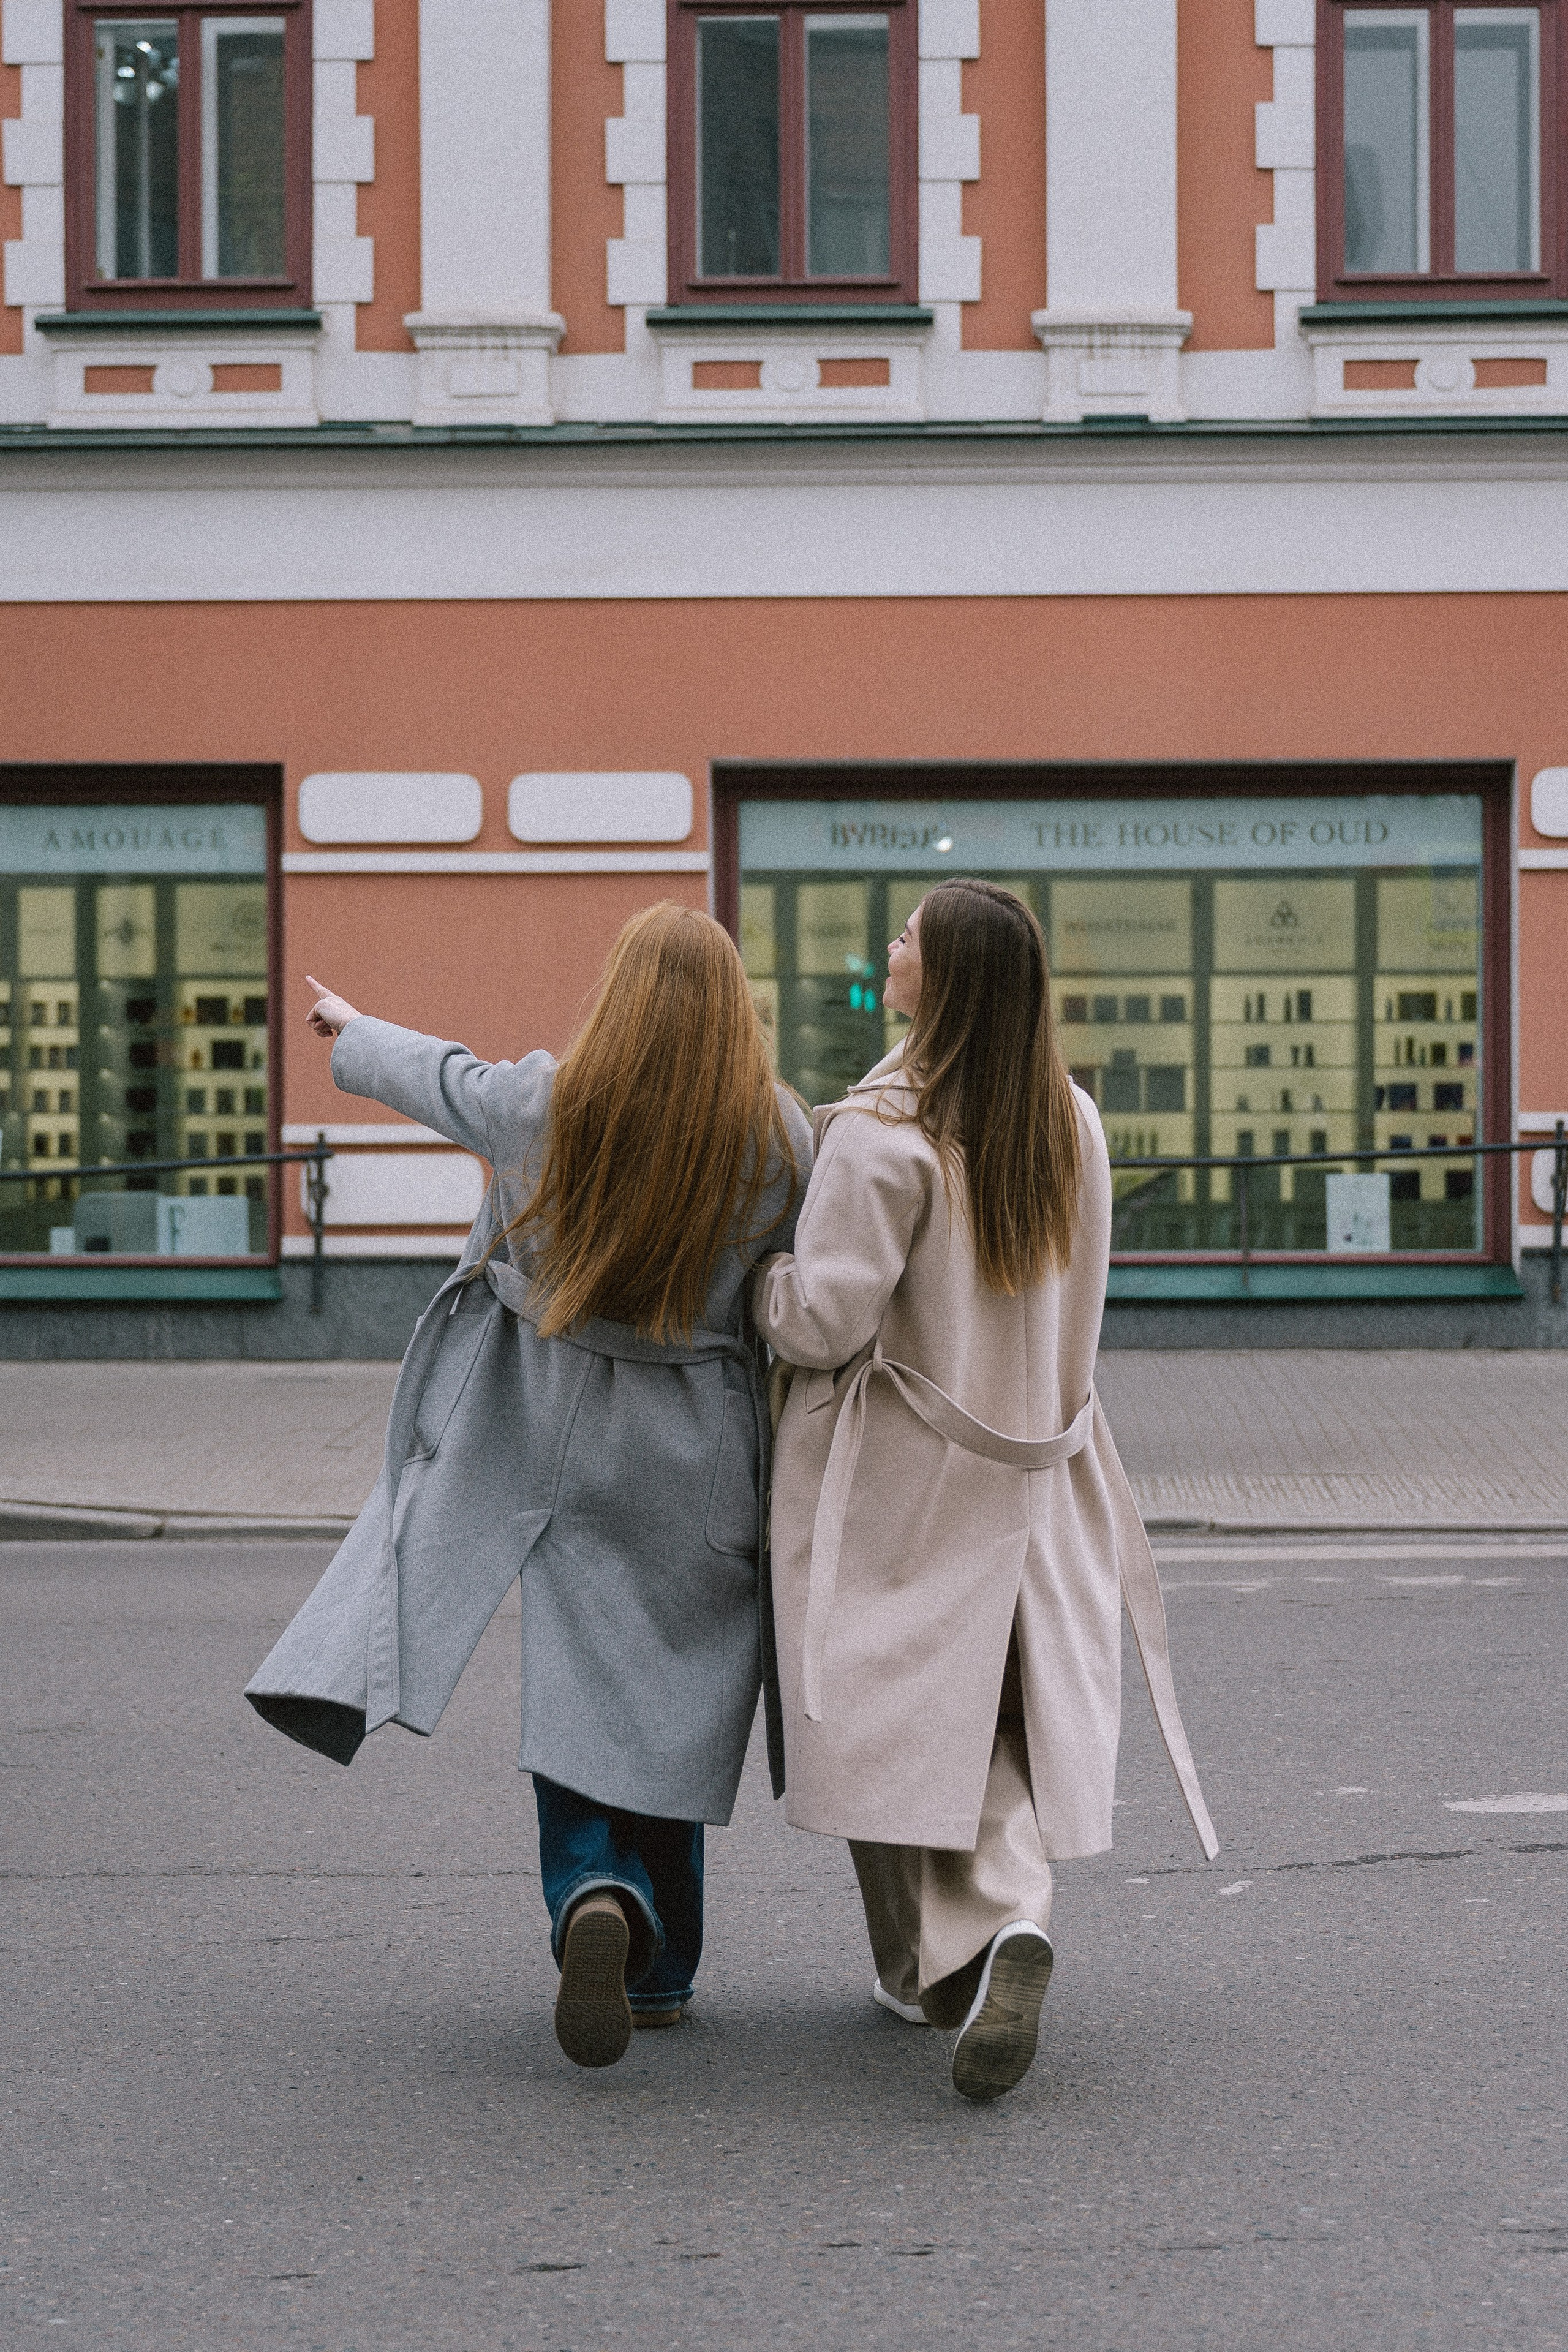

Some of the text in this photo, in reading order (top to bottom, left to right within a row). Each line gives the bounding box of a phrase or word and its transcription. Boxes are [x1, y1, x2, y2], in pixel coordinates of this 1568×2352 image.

[42, 826, 228, 853] AMOUAGE
[1029, 818, 1390, 849] THE HOUSE OF OUD
